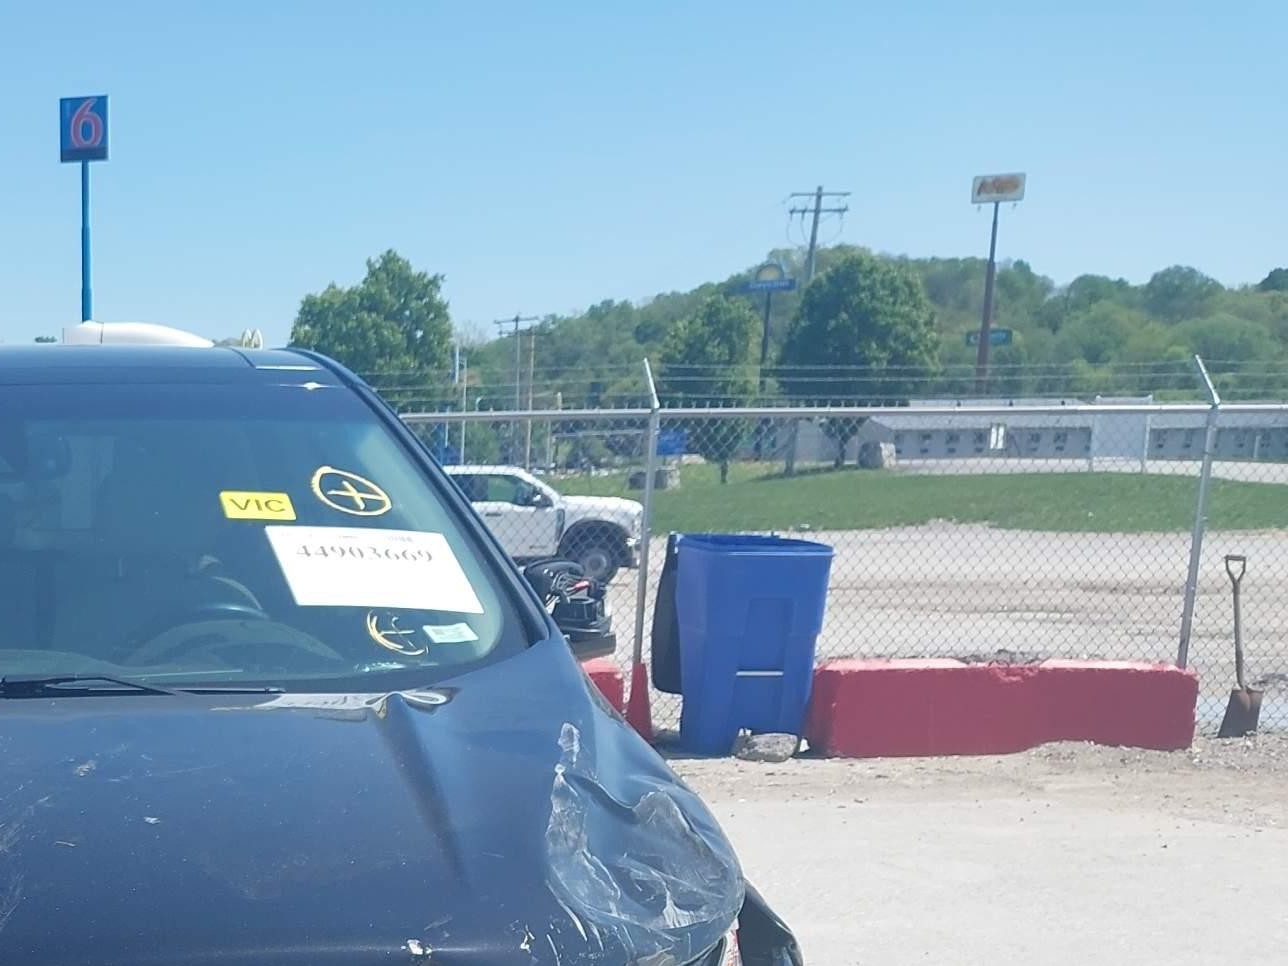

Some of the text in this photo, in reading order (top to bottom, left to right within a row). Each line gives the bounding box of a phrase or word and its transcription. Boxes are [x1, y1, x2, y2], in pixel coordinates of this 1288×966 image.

[70, 97, 104, 148] 6
[228, 498, 286, 514] VIC
[295, 543, 434, 563] 44903669
